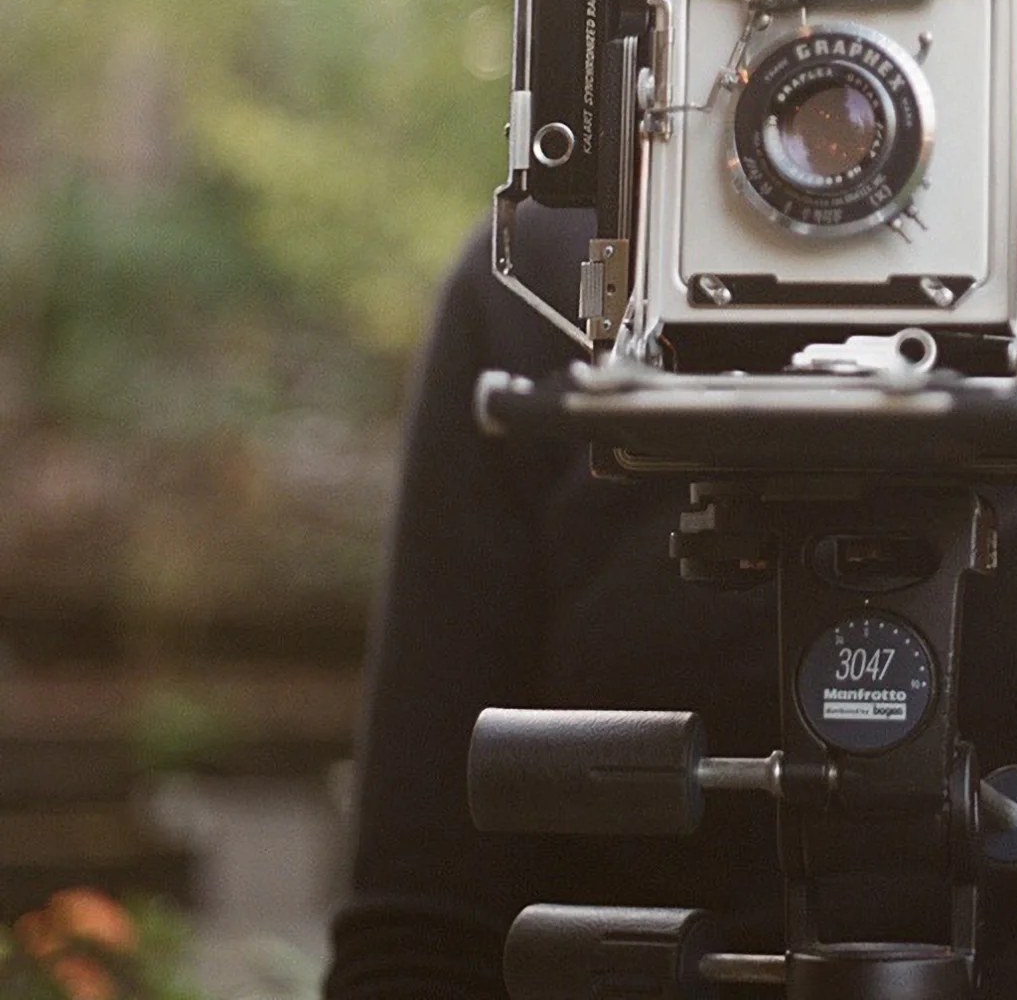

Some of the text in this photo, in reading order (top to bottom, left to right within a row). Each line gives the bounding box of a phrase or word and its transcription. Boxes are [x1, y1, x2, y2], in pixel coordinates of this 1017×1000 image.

[583, 19, 597, 107] SYNCHRONIZED
[796, 40, 906, 91] GRAPHEX
[777, 66, 834, 103] GRAFLEX
[583, 109, 594, 155] KALART
[836, 648, 895, 681] 3047
[823, 688, 907, 702] Manfrotto
